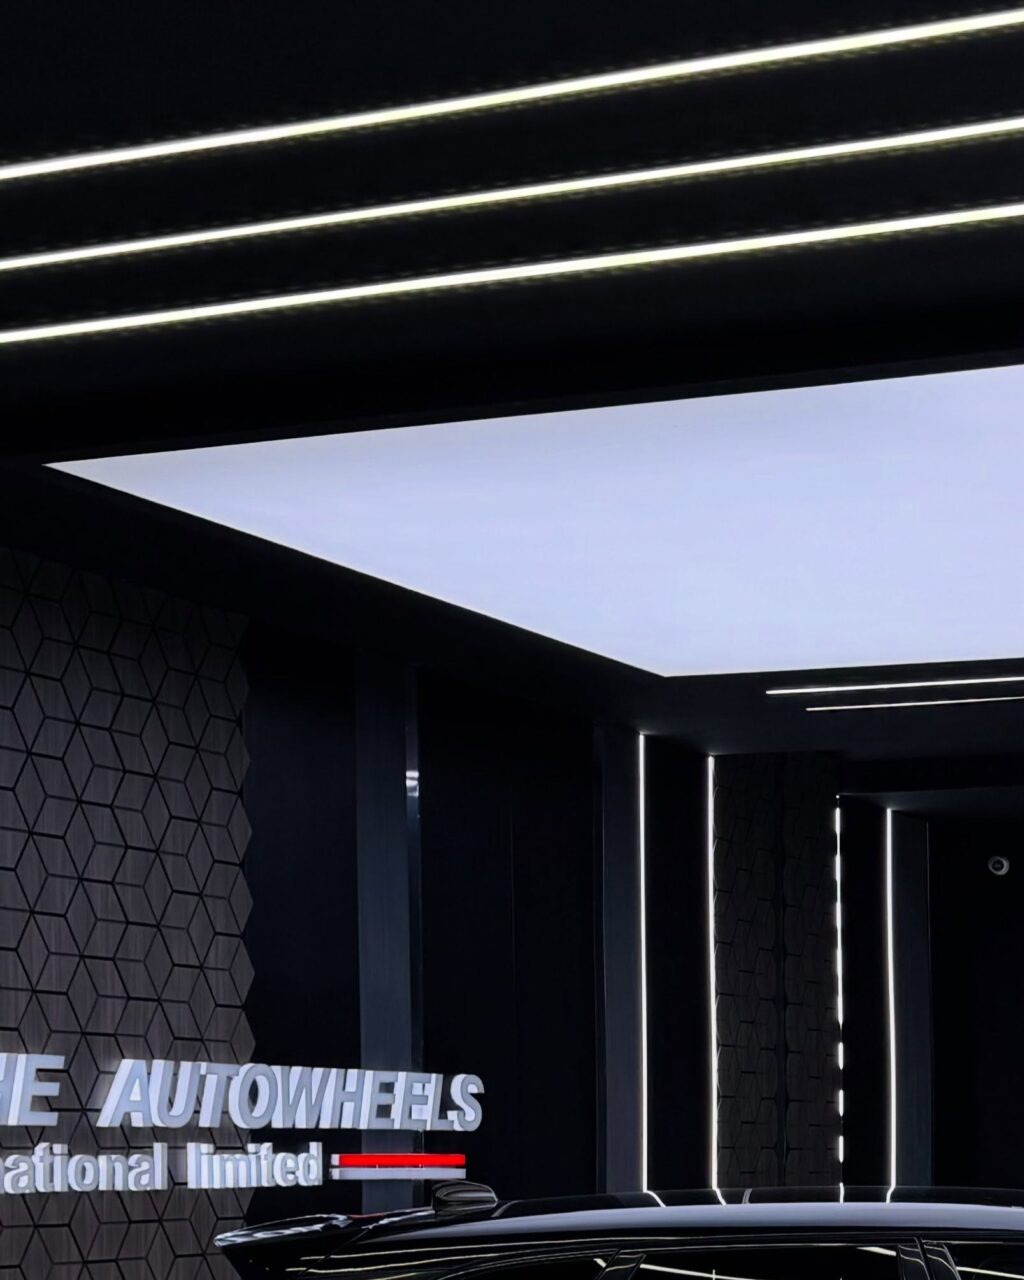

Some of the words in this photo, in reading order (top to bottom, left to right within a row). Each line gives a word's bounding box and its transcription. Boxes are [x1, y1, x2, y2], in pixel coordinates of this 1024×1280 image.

[96, 1058, 485, 1131] AUTOWHEELS
[0, 1142, 168, 1194] ational
[187, 1142, 323, 1190] limited
